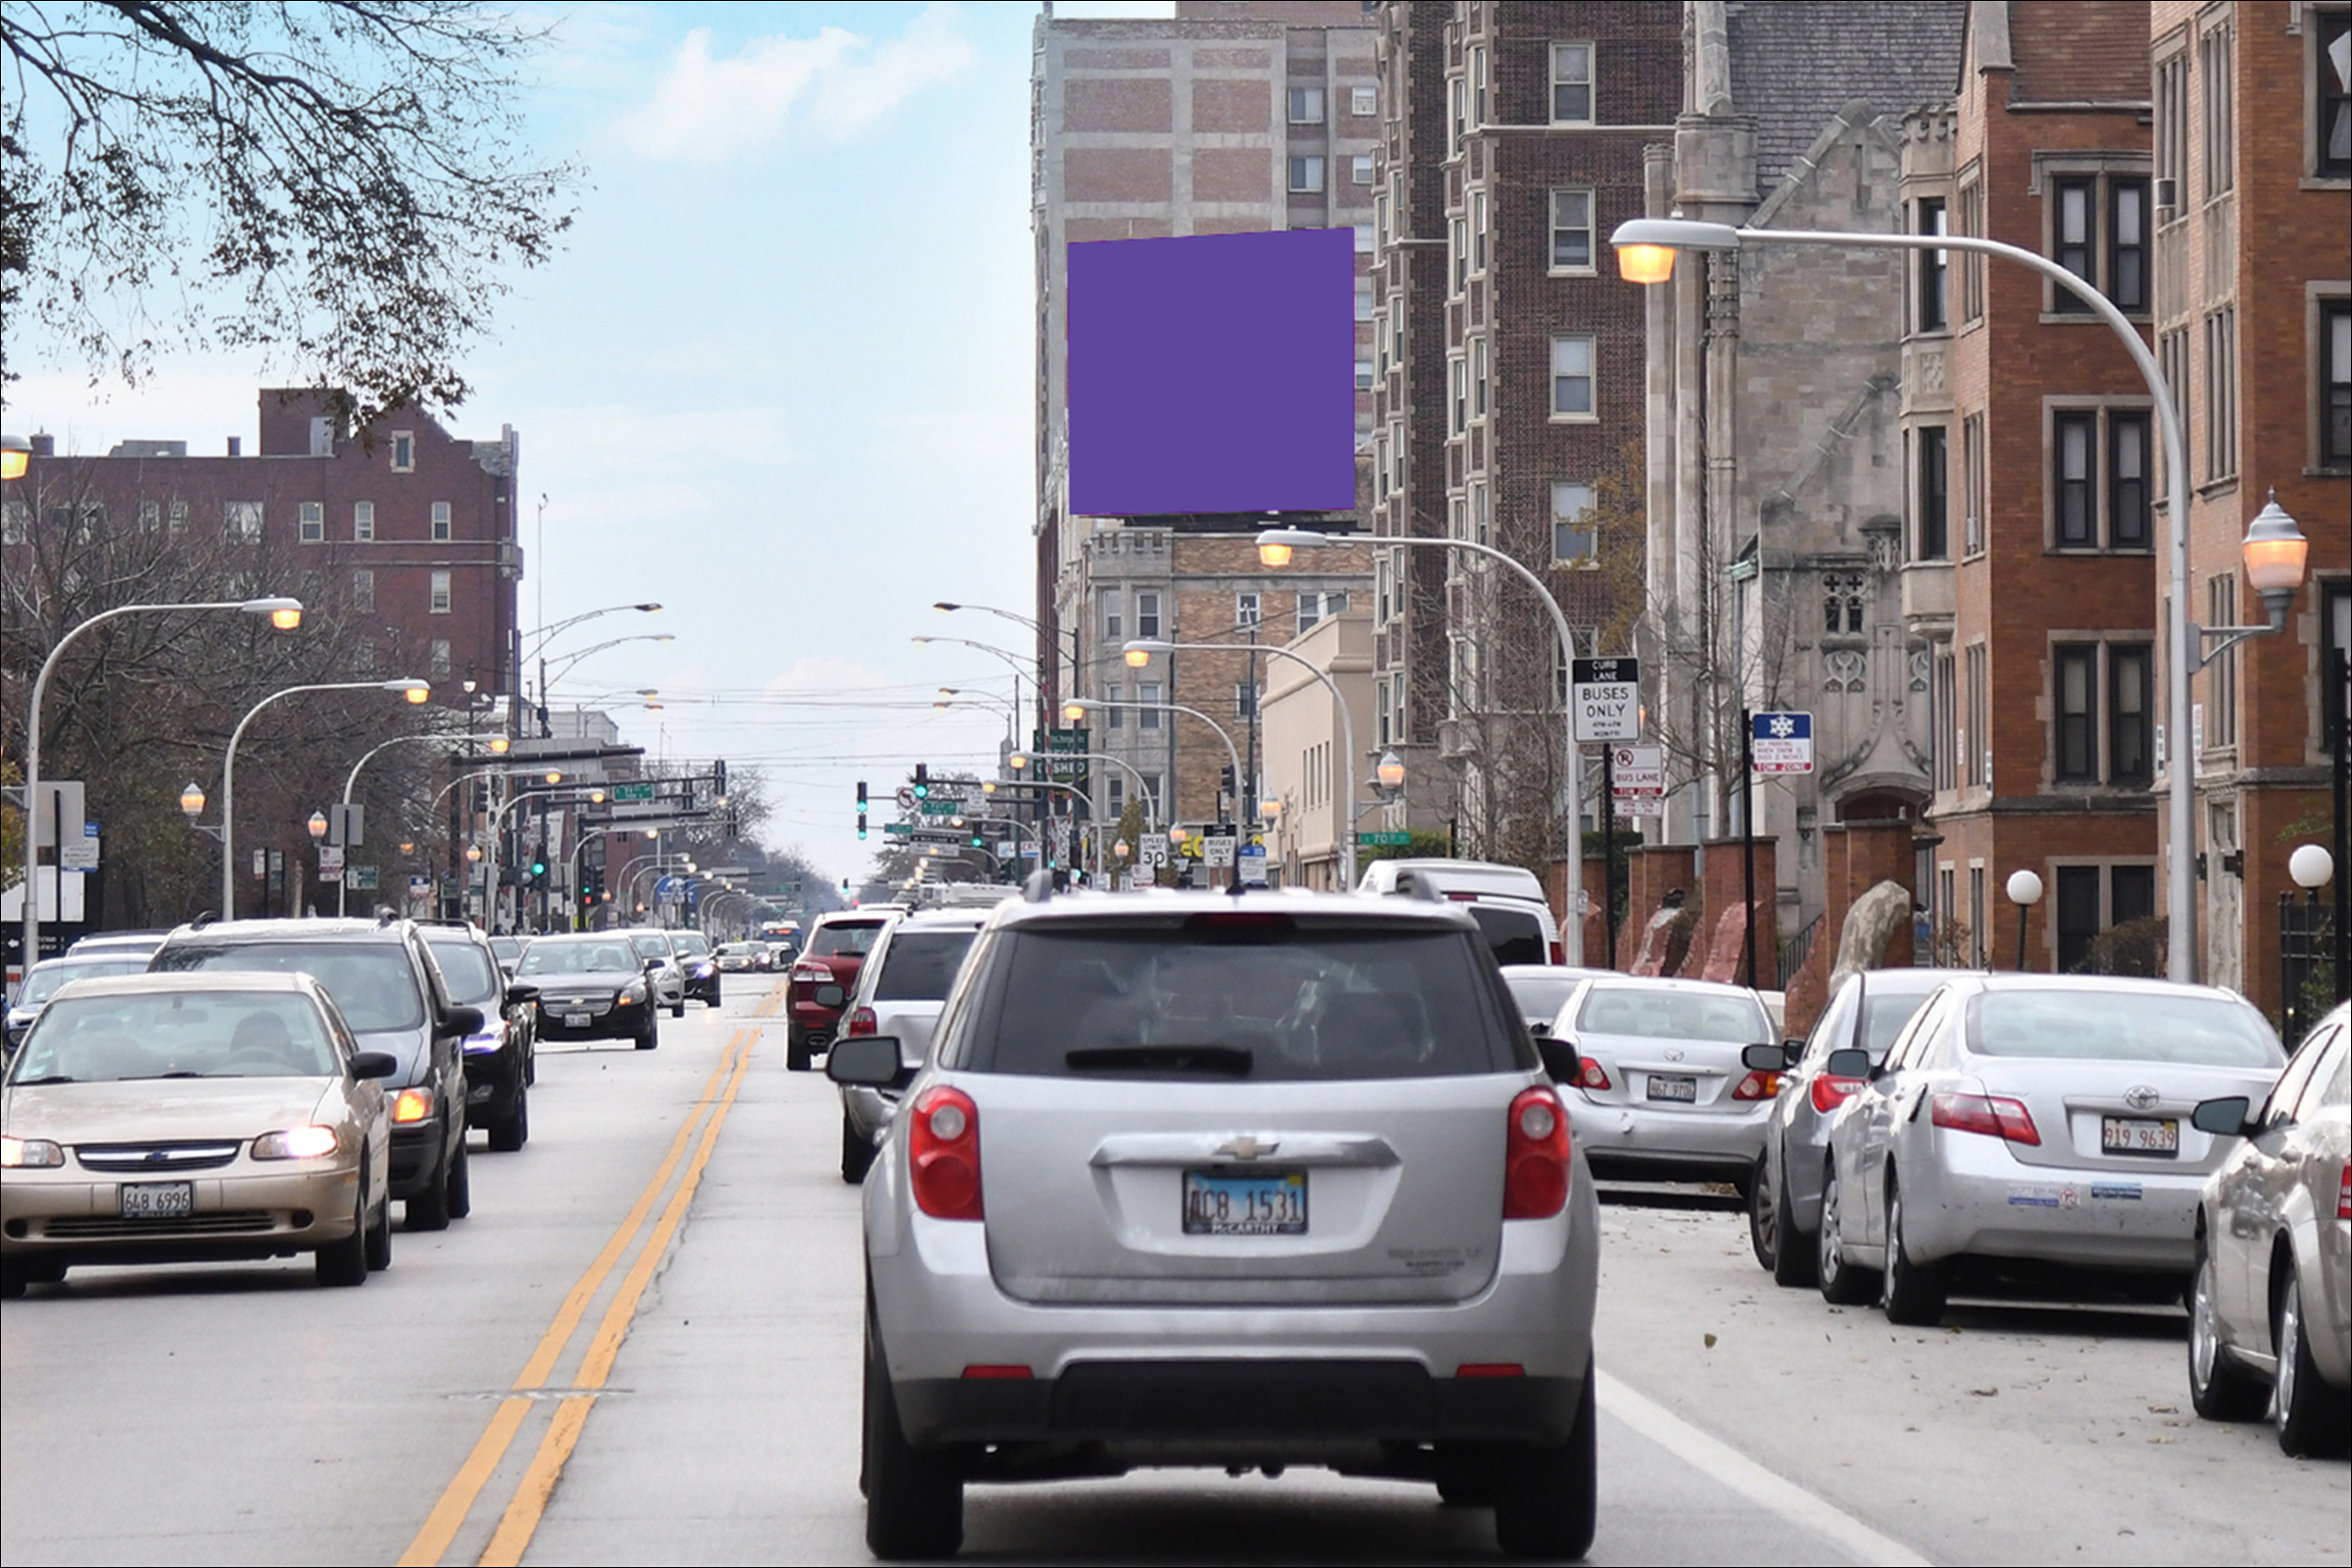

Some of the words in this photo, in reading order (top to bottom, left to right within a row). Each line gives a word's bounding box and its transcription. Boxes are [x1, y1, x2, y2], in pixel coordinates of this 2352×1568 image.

[1592, 672, 1617, 681] LANE
[1583, 688, 1629, 701] BUSES
[1587, 704, 1626, 717] ONLY
[1616, 773, 1633, 782] BUS
[1637, 773, 1659, 782] LANE
[1143, 851, 1164, 864] 30
[2106, 1128, 2131, 1147] 919
[2139, 1129, 2176, 1149] 9639
[125, 1193, 149, 1210] 648
[157, 1191, 189, 1209] 6996
[1246, 1191, 1300, 1221] 1531
